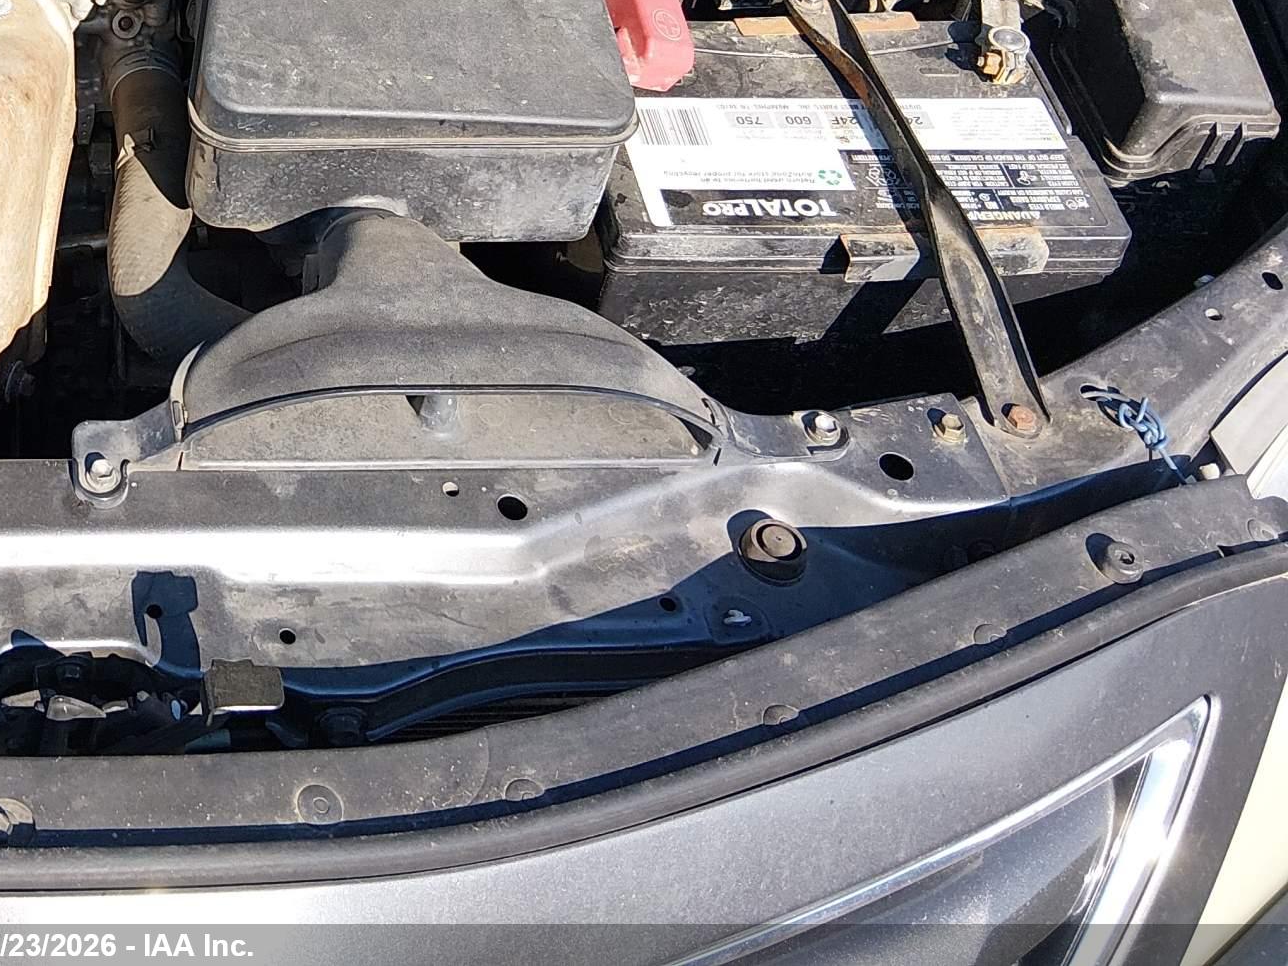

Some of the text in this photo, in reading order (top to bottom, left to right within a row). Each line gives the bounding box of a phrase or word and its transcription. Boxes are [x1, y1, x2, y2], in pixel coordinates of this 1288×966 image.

[735, 116, 763, 125] 750
[785, 116, 812, 125] 600
[831, 116, 859, 125] 24F
[702, 198, 838, 217] TOTALPRO
[966, 210, 1031, 221] DANGER/P
